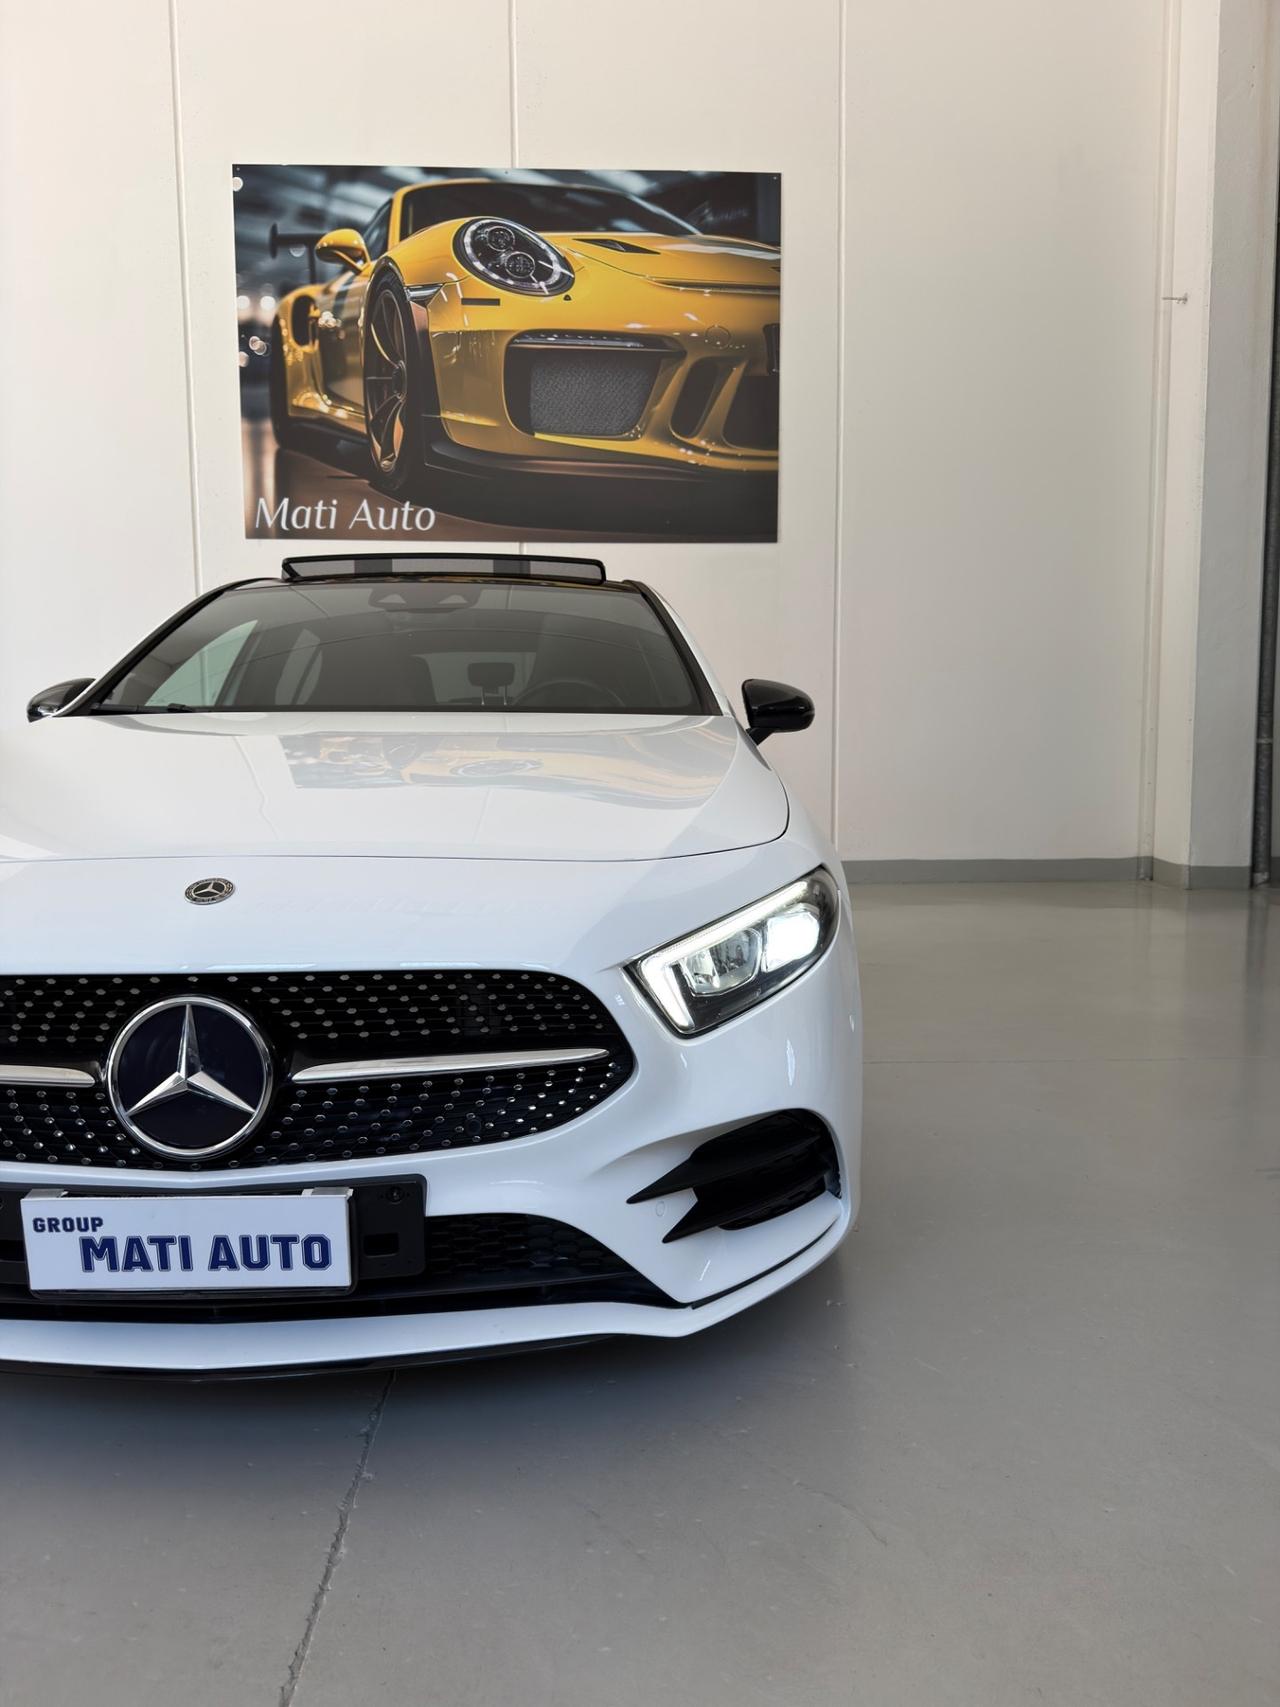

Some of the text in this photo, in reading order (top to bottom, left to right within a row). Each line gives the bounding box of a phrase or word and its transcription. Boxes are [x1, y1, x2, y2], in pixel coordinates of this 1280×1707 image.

[255, 497, 436, 532] Mati Auto
[32, 1216, 104, 1233] GROUP
[79, 1233, 333, 1273] MATI AUTO
